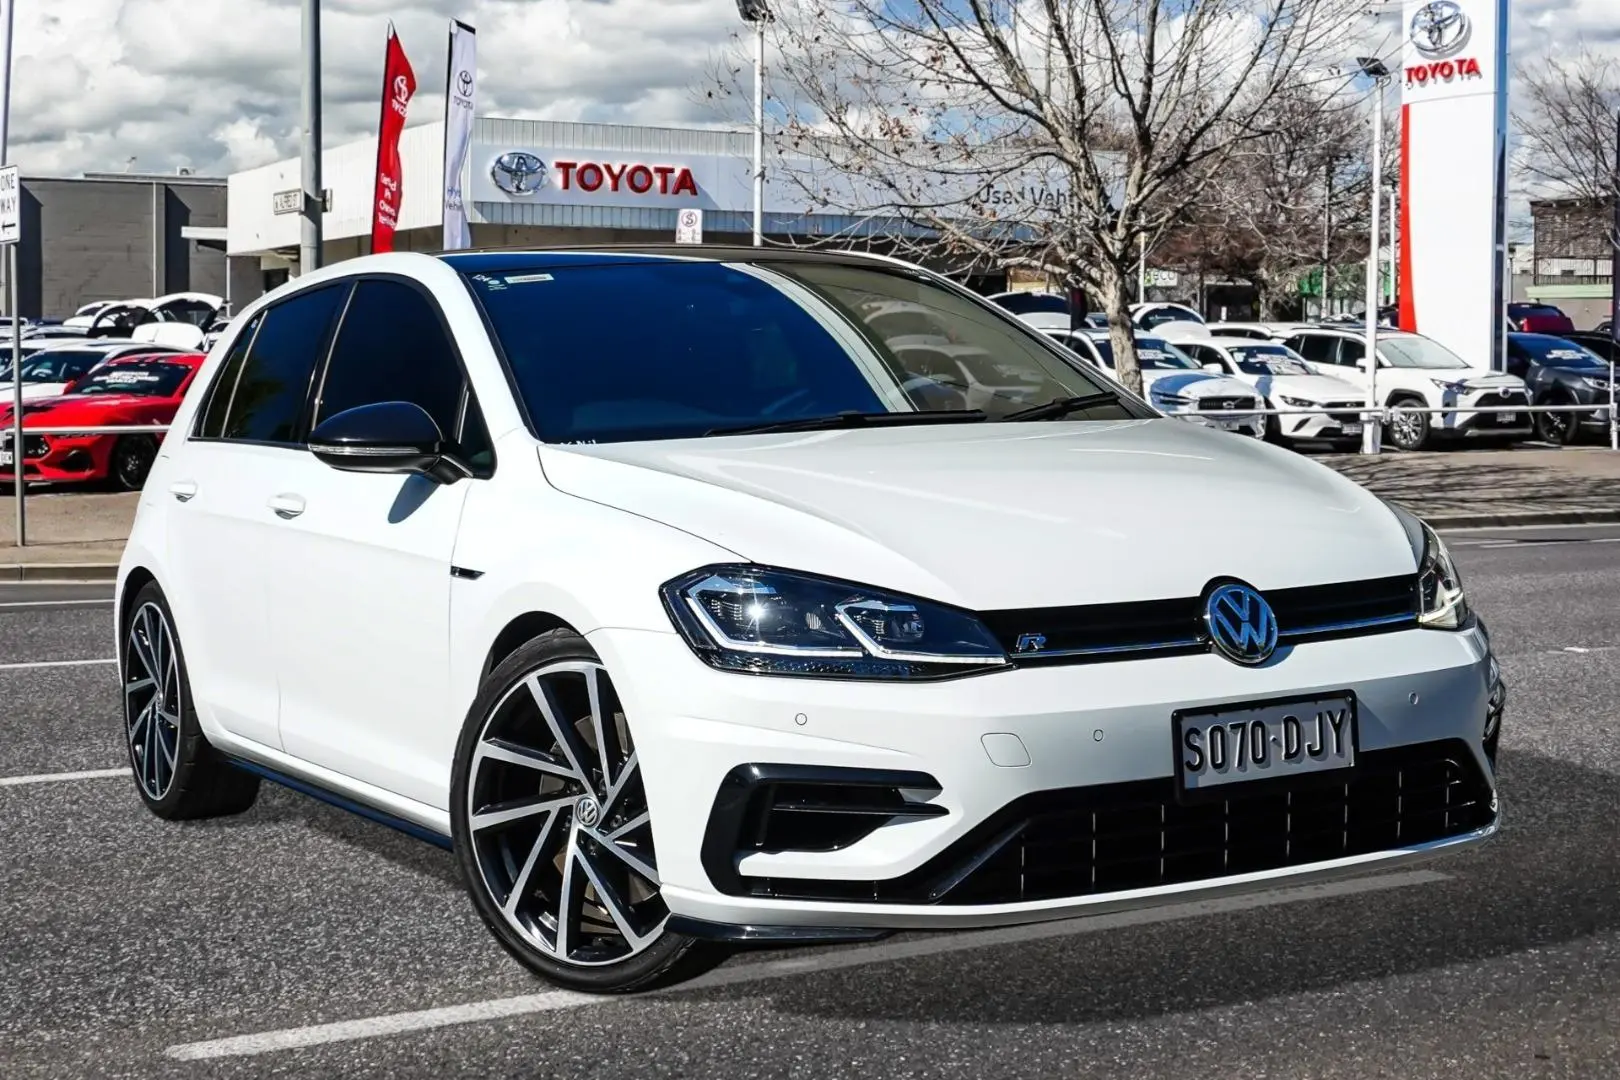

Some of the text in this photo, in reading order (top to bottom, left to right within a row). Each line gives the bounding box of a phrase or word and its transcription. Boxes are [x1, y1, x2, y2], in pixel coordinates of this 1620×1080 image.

[1404, 58, 1481, 82] TOYOTA
[1, 173, 15, 191] ONE
[555, 161, 698, 196] TOYOTA
[1, 196, 17, 214] WAY
[1030, 186, 1068, 207] Veh
[1016, 633, 1047, 652] R
